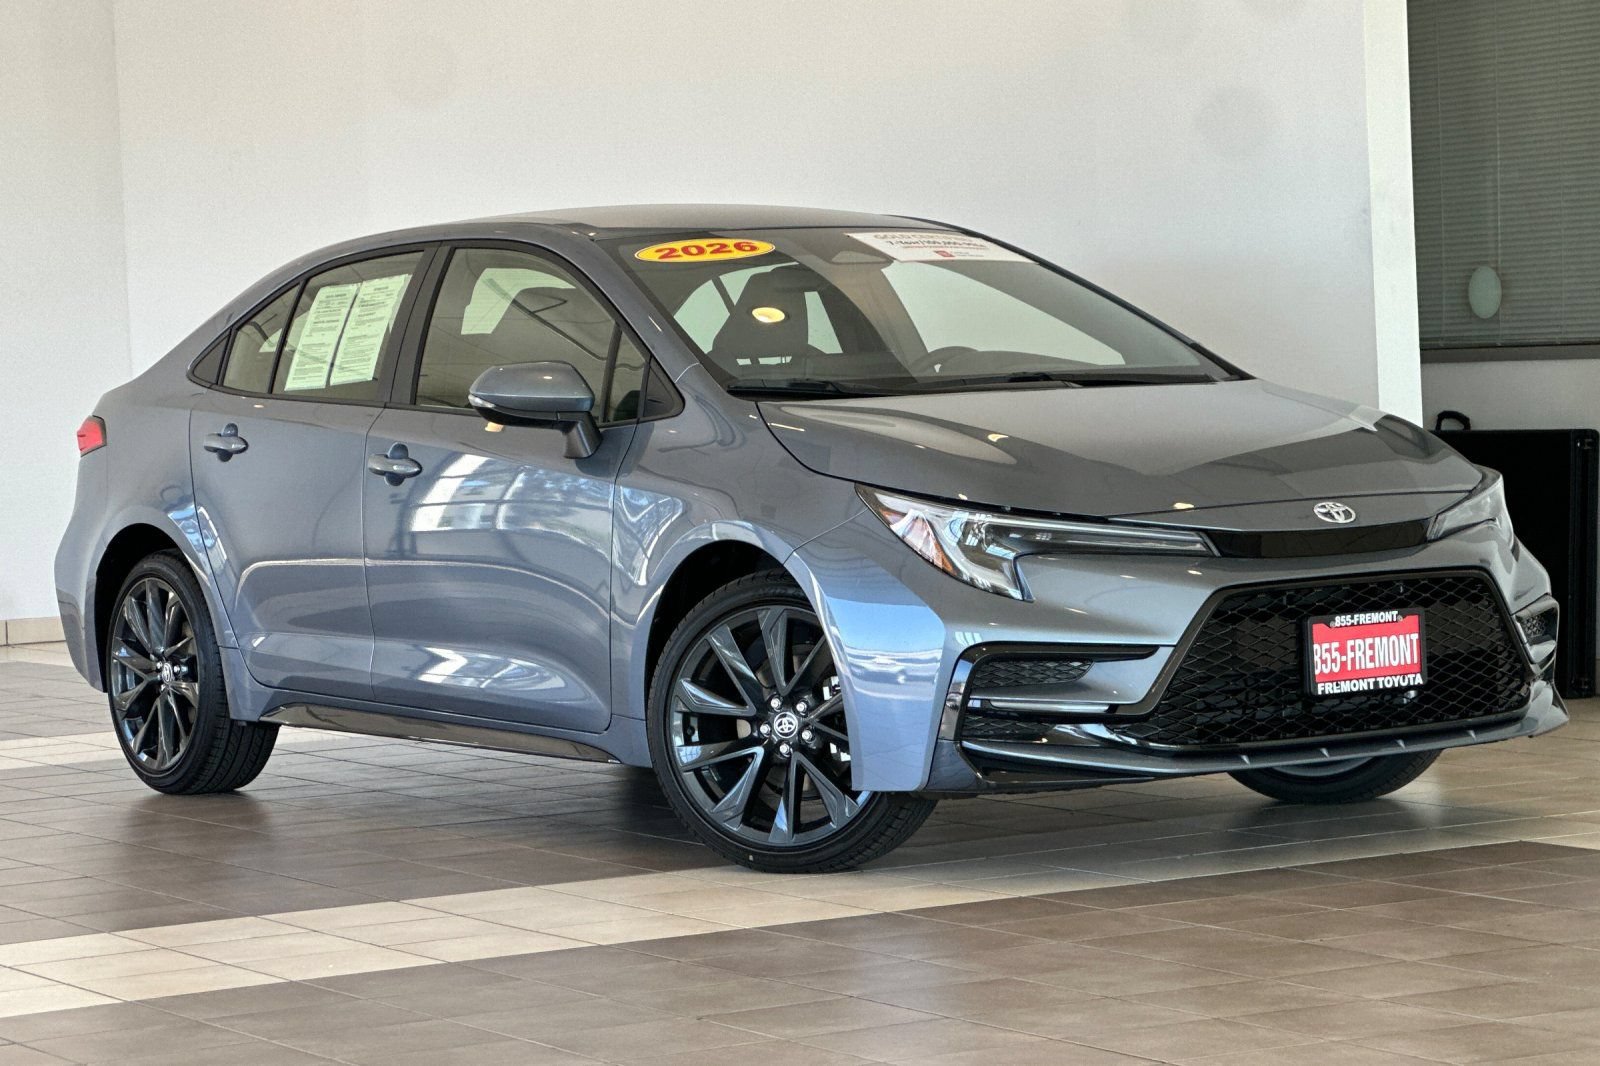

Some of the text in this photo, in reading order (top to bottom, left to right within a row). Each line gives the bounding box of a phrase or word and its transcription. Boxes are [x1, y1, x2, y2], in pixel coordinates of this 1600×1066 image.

[655, 242, 759, 259] 2026
[1335, 611, 1398, 626] 855-FREMONT
[1313, 633, 1419, 675] 855-FREMONT
[1317, 673, 1423, 695] FREMONT TOYOTA
